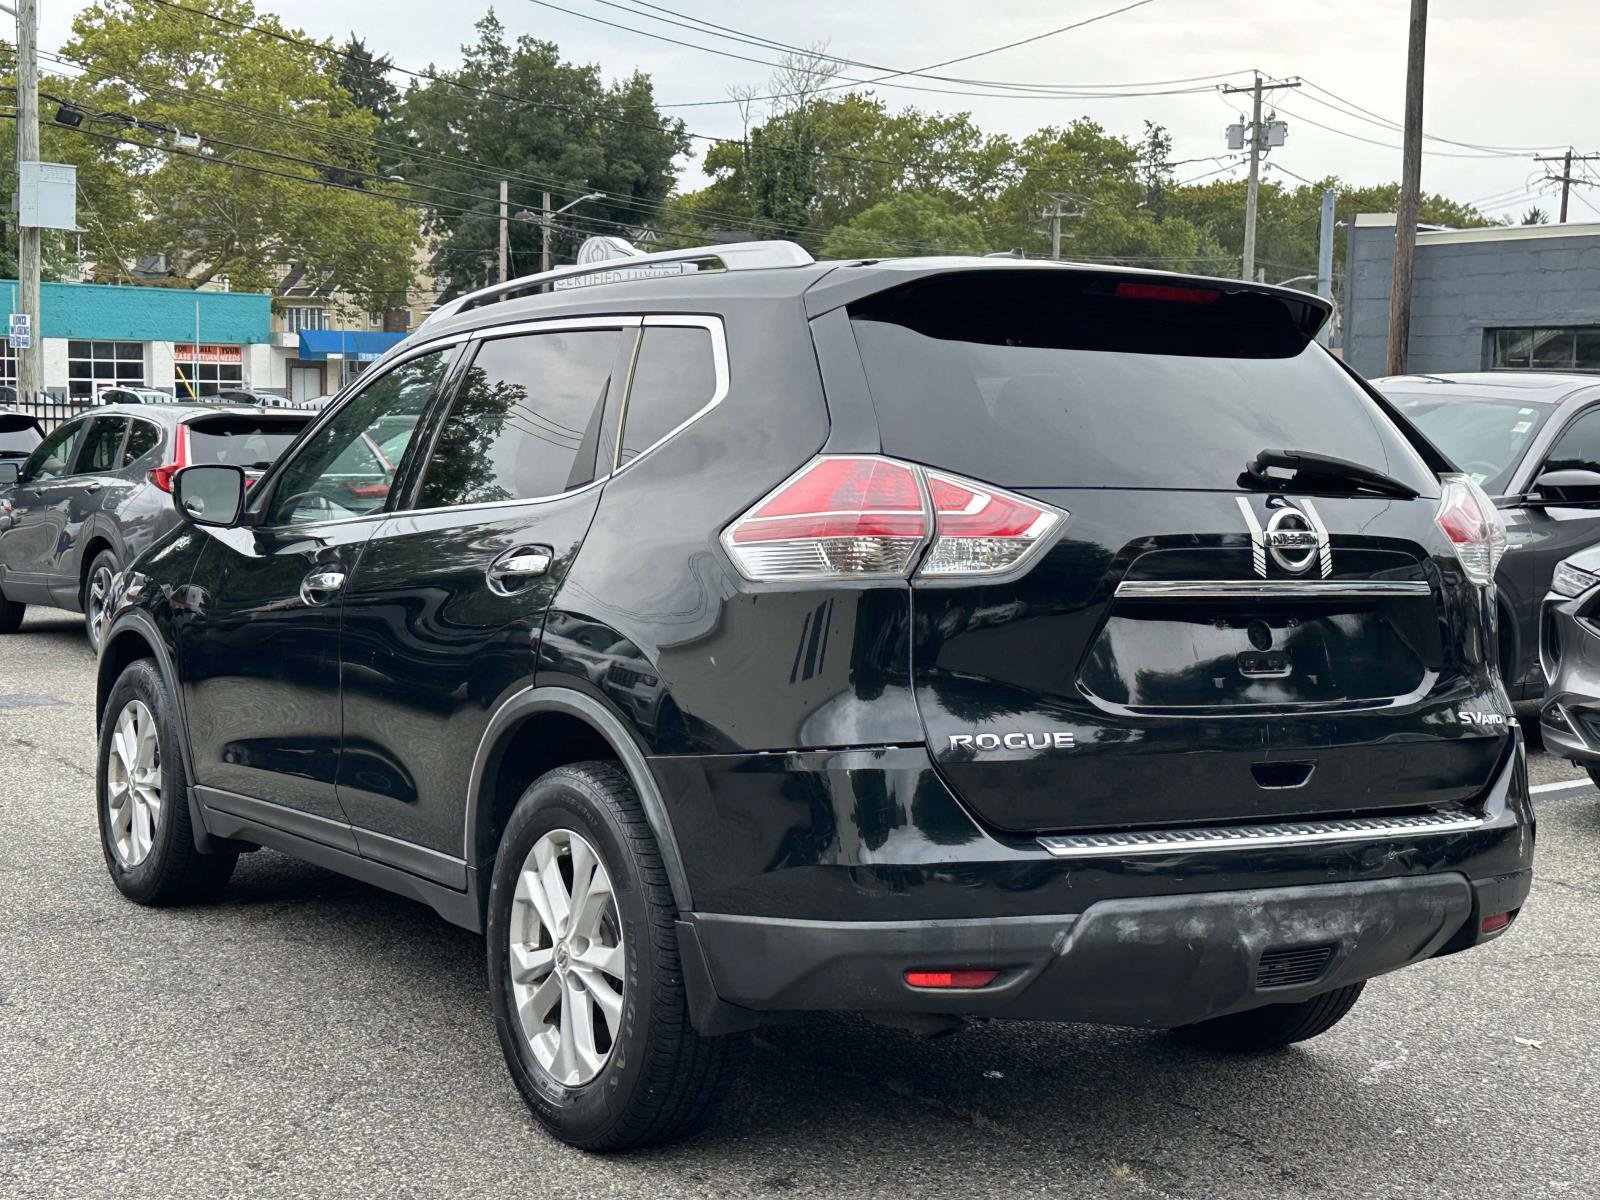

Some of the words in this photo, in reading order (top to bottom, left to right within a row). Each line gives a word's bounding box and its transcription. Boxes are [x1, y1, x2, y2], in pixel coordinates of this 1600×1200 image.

[219, 354, 241, 362] NEEDS
[1272, 533, 1318, 546] NISSAN
[1458, 711, 1482, 724] SV
[948, 732, 1076, 751] ROGUE
